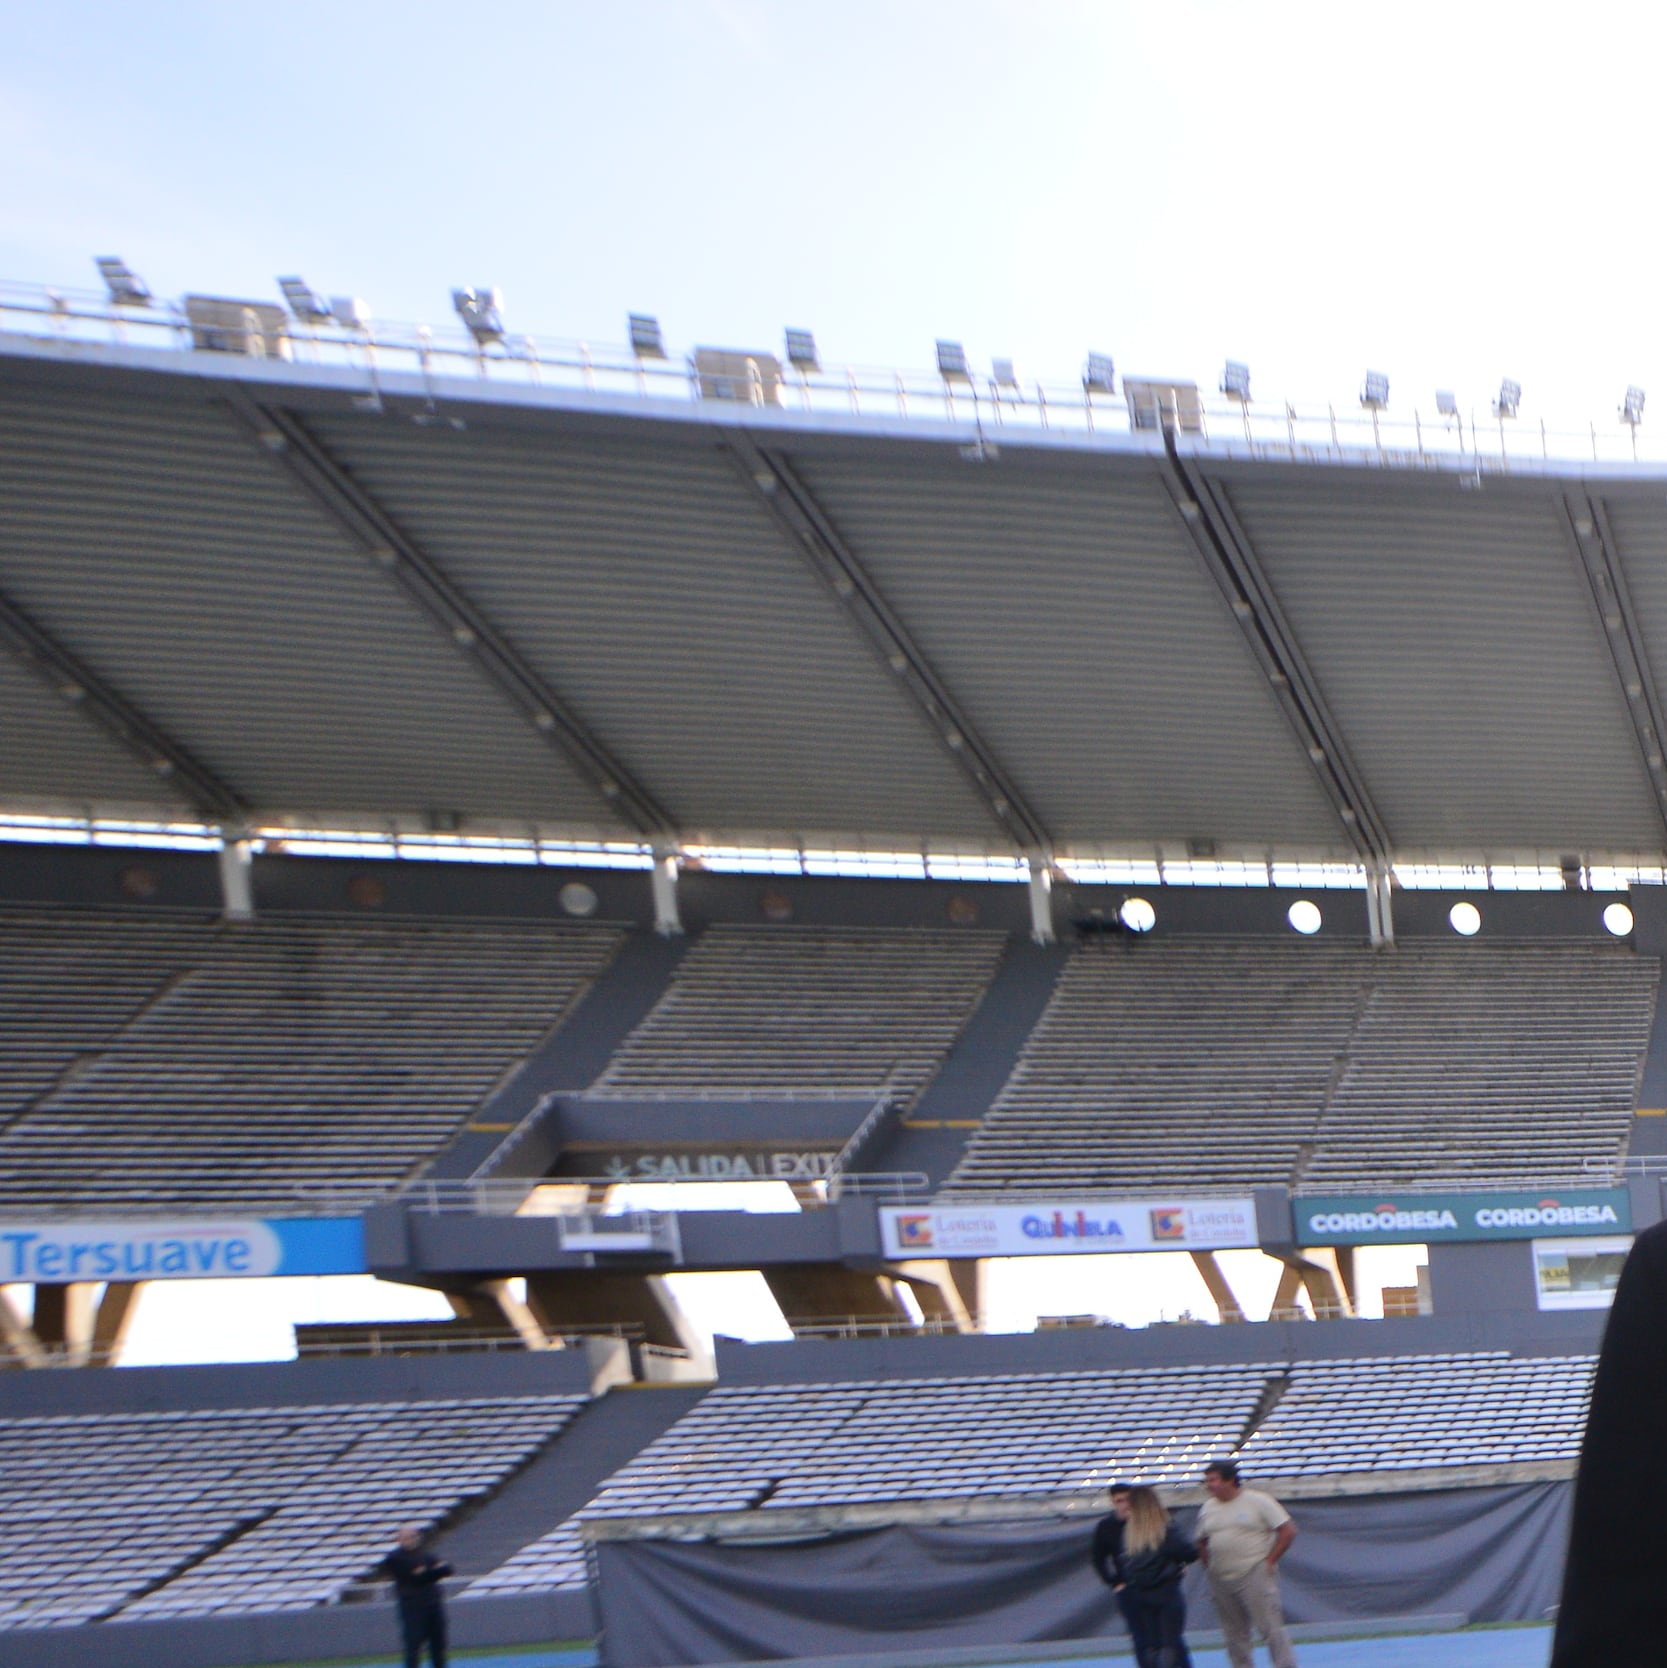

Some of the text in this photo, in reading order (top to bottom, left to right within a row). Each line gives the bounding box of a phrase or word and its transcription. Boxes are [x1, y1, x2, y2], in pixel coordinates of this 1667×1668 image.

[635, 1152, 837, 1178] SALIDA EXIT
[1309, 1205, 1618, 1234] CORDOBESA CORDOBESA
[2, 1233, 250, 1276] Tersuave
